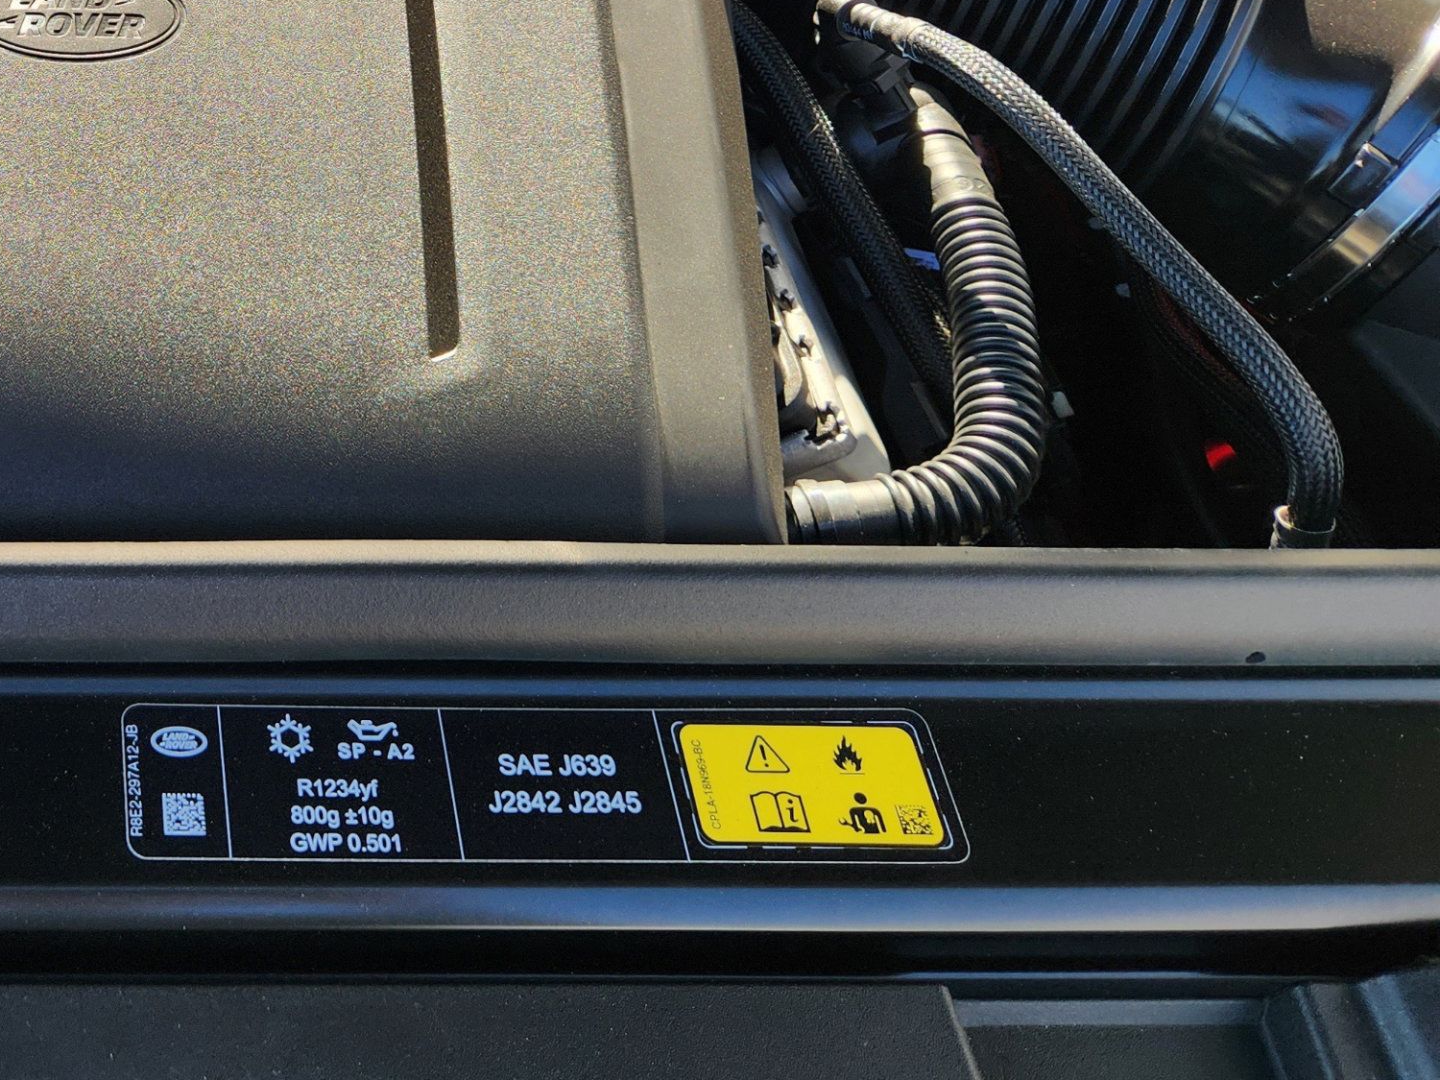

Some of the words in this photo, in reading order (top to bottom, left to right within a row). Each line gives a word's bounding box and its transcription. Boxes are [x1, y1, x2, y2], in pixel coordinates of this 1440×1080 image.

[18, 12, 146, 39] ROVER
[338, 742, 364, 760] SP
[388, 743, 416, 761] A2
[498, 754, 552, 777] SAE
[559, 754, 616, 777] J639
[126, 724, 143, 838] R8E2-297A12-JB
[297, 779, 378, 802] R1234yf
[691, 739, 722, 830] CPLA-18N969-BC
[489, 791, 563, 814] J2842
[569, 791, 643, 814] J2845
[291, 805, 340, 829] 800g
[345, 806, 394, 829] ±10g
[290, 832, 343, 853] GWP
[347, 833, 401, 854] 0.501
